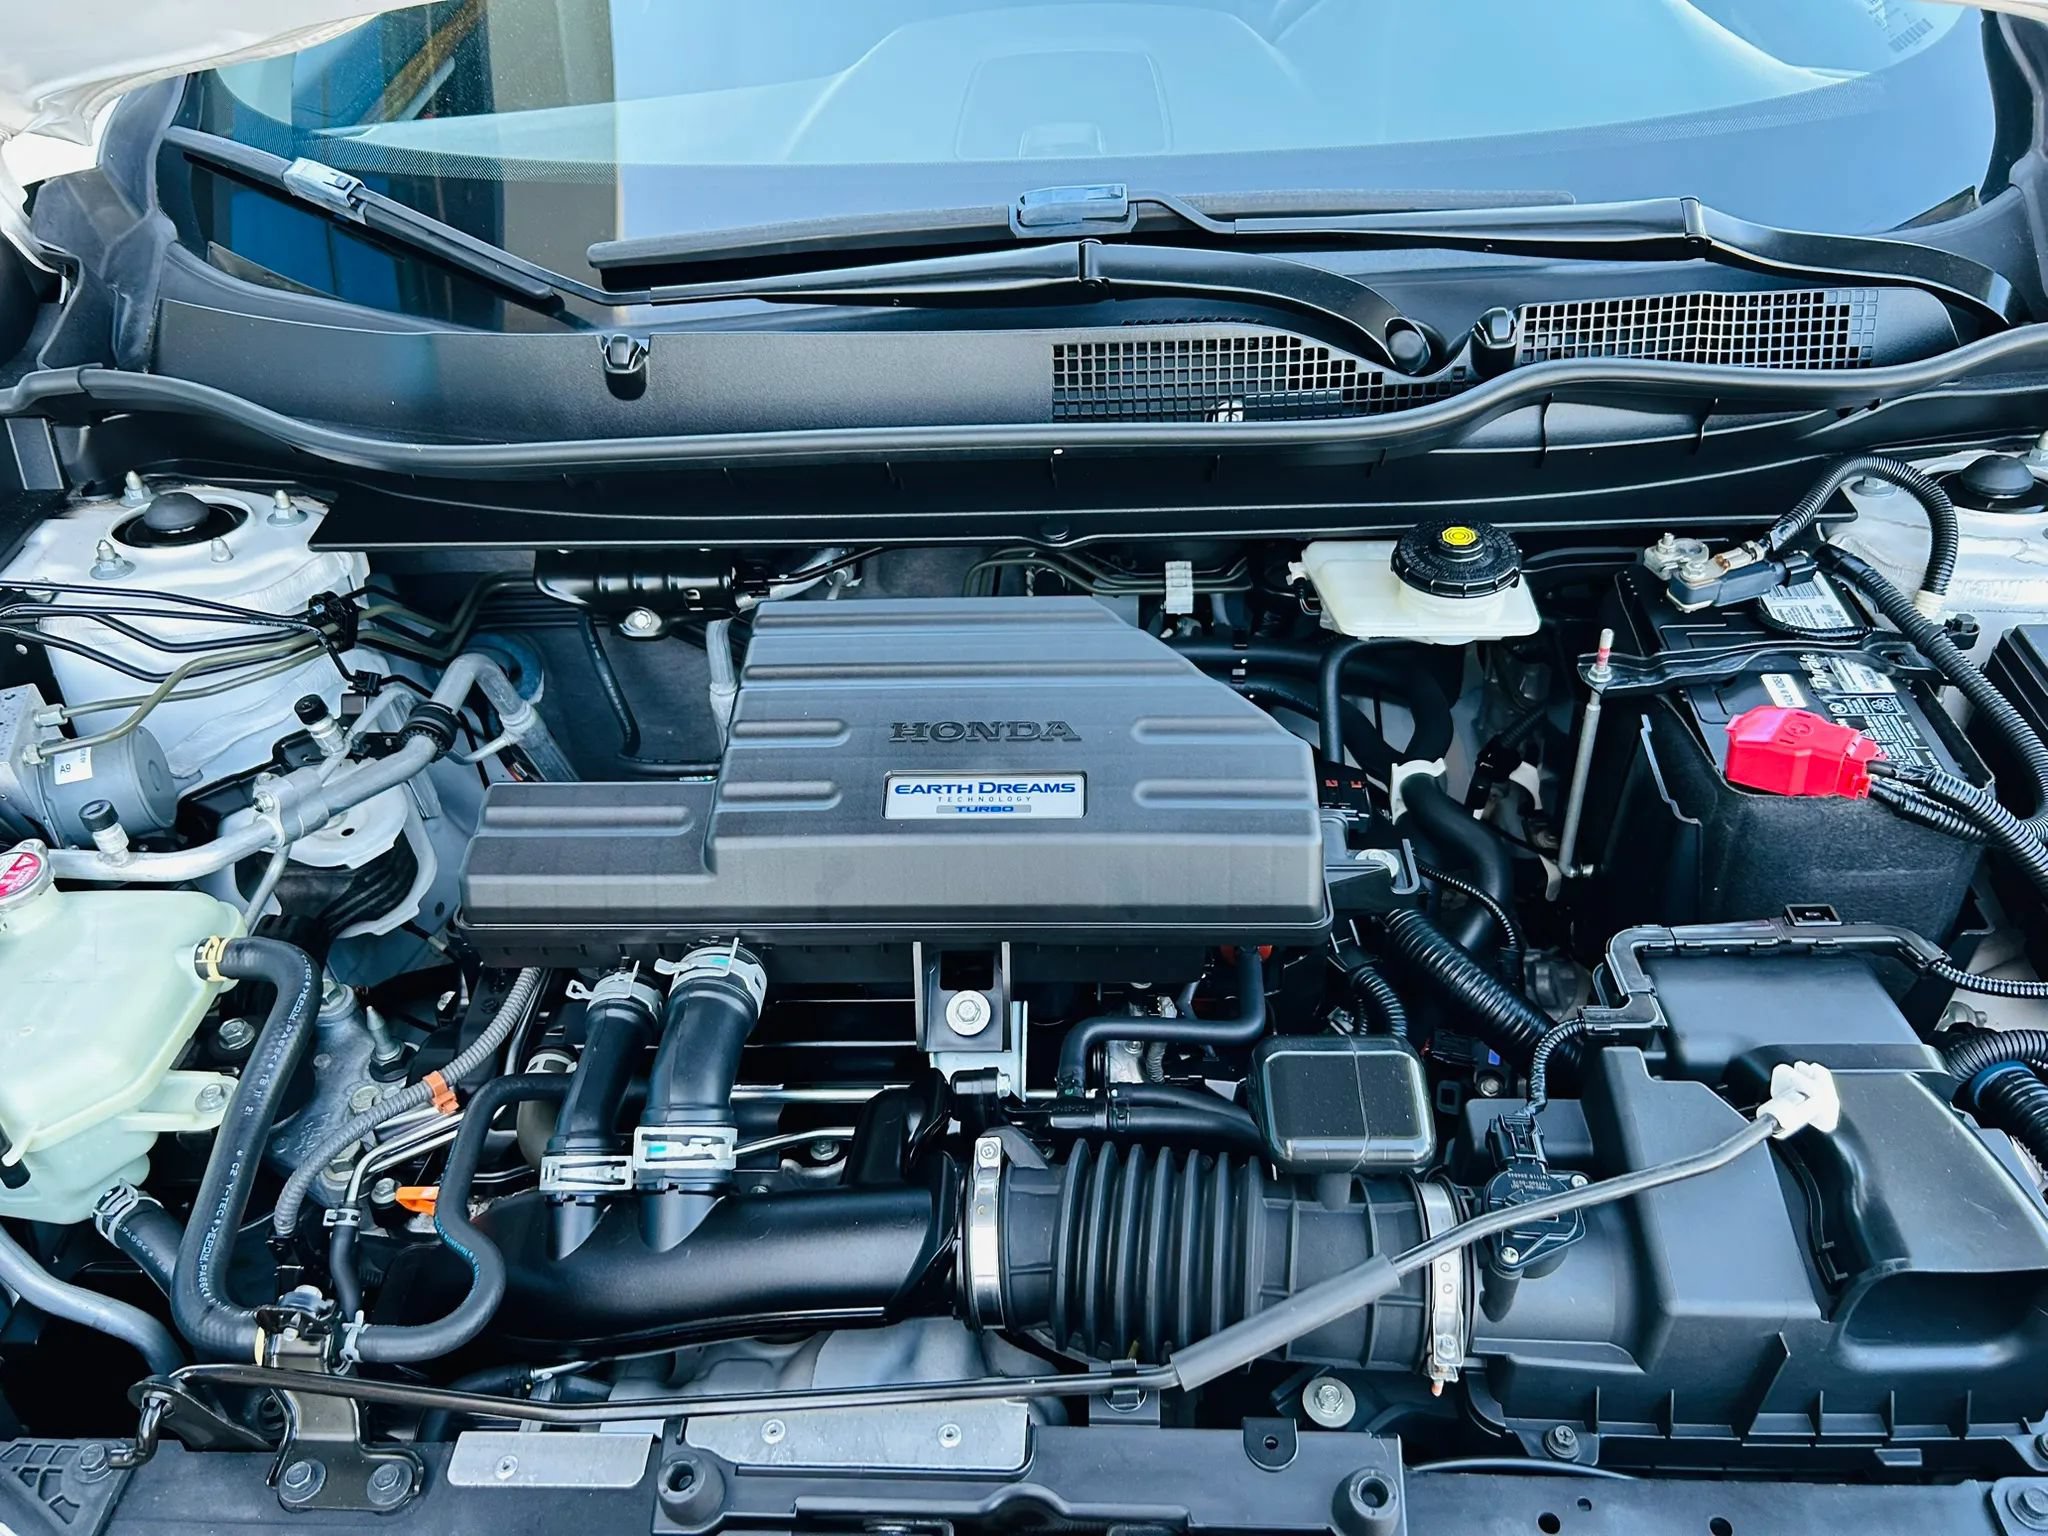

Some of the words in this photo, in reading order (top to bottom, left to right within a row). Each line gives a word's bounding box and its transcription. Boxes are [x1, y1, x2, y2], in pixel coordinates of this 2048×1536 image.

[889, 721, 1082, 742] HONDA
[60, 763, 71, 774] A9
[895, 784, 973, 795] EARTH
[978, 782, 1076, 793] DREAMS
[955, 805, 1014, 813] TURBO
